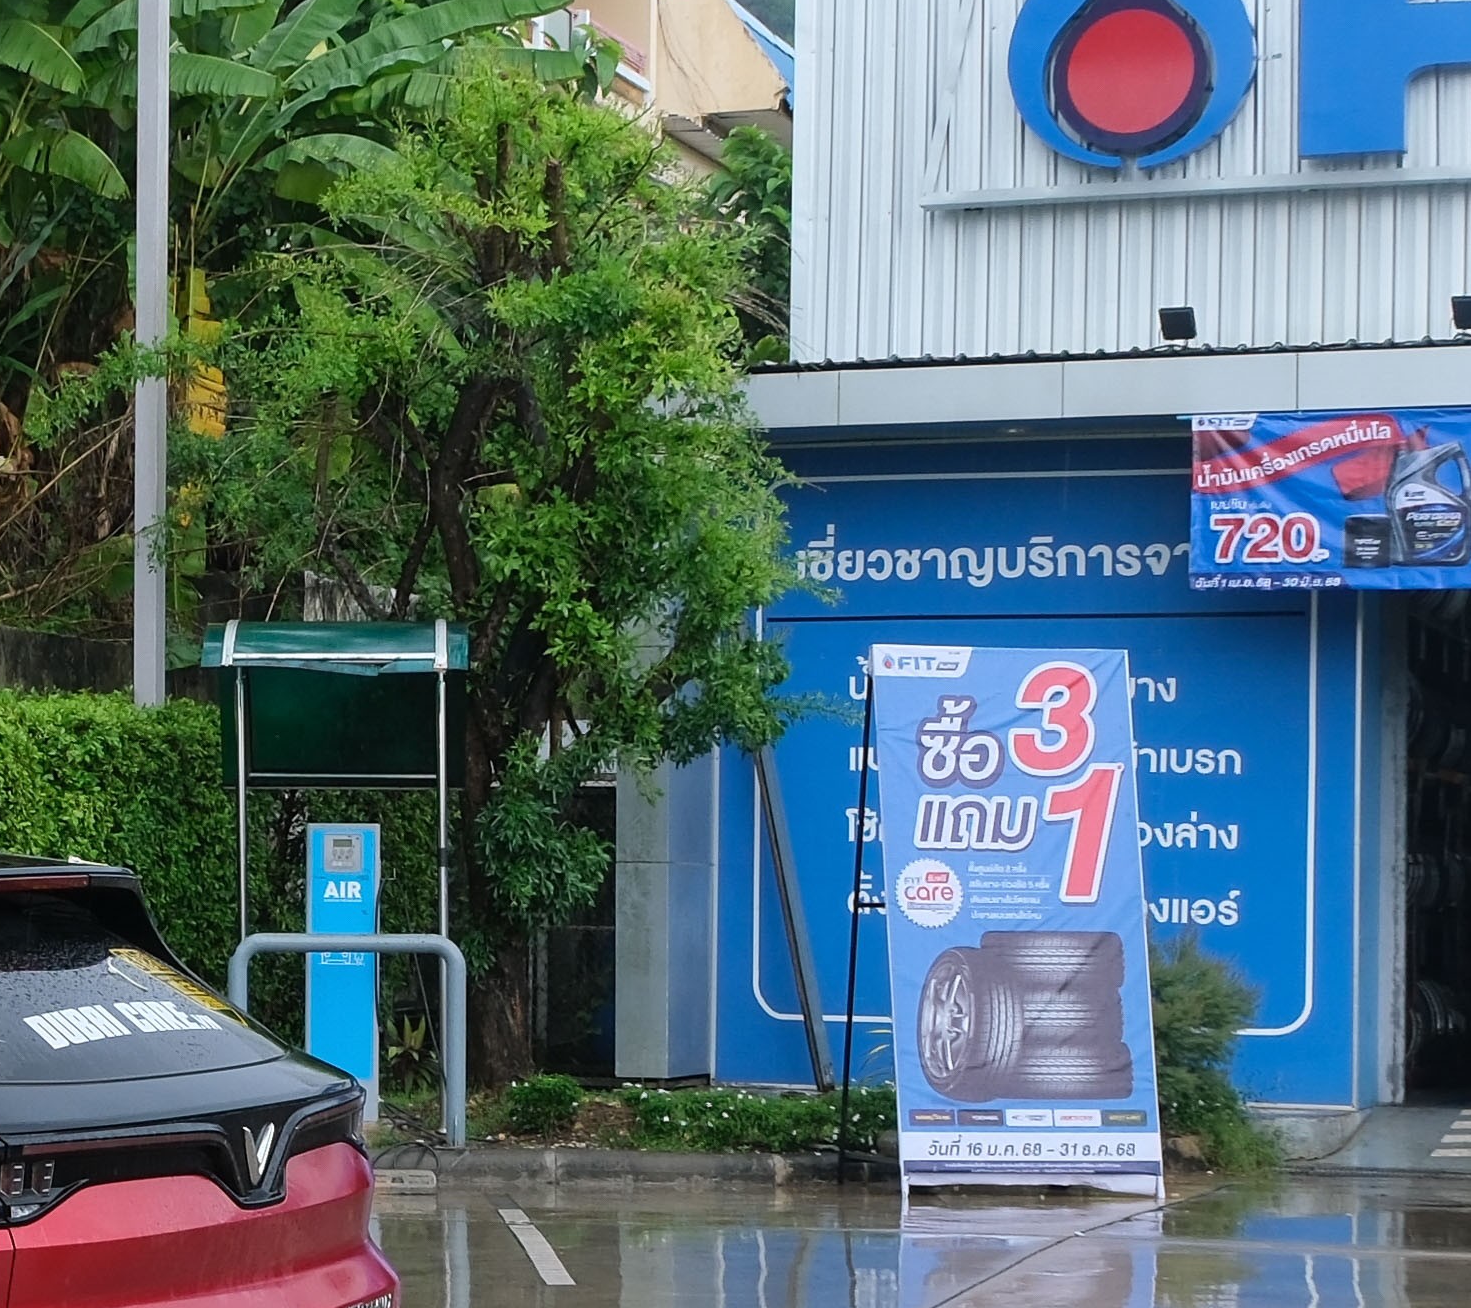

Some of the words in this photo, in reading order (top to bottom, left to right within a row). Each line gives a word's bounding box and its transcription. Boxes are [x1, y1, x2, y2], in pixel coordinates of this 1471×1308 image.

[897, 656, 936, 670] FIT
[921, 700, 999, 780] ซื้อ
[1010, 663, 1095, 774] 3
[916, 796, 1036, 848] แถม
[1044, 765, 1120, 900] 1
[1137, 811, 1238, 850] วงล่าง
[323, 880, 362, 899] AIR
[904, 886, 954, 901] care
[23, 1004, 132, 1050] DUBAI
[928, 1134, 961, 1156] วันที่
[966, 1143, 982, 1156] 16
[1023, 1143, 1042, 1157] 68
[1060, 1143, 1078, 1157] 31
[1116, 1143, 1136, 1157] 68
